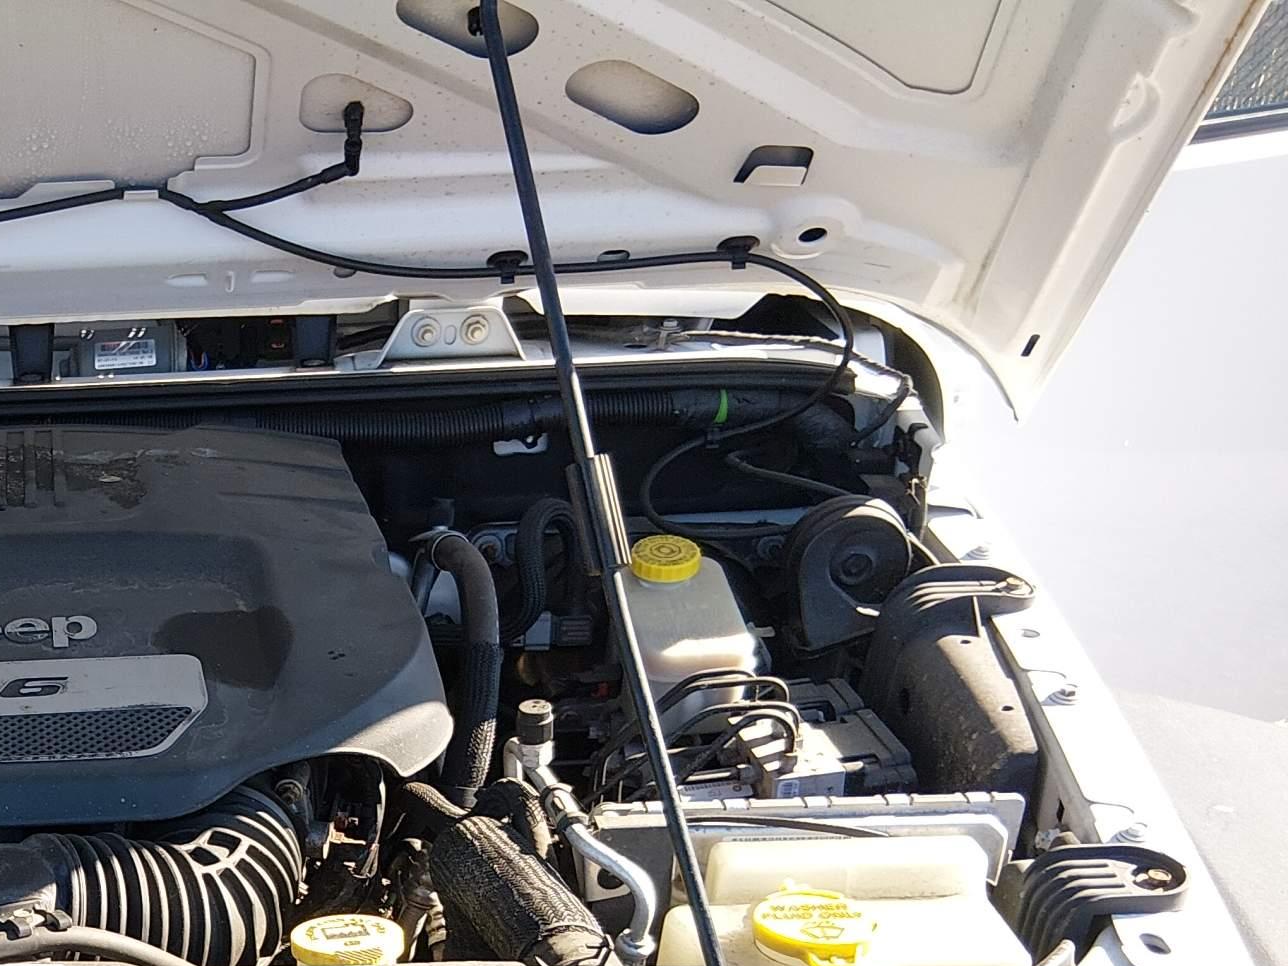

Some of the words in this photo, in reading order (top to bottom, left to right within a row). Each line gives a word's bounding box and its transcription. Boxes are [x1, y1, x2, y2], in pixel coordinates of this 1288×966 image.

[770, 903, 848, 911] WASHER
[761, 911, 813, 920] FLUID
[818, 911, 862, 919] ONLY
